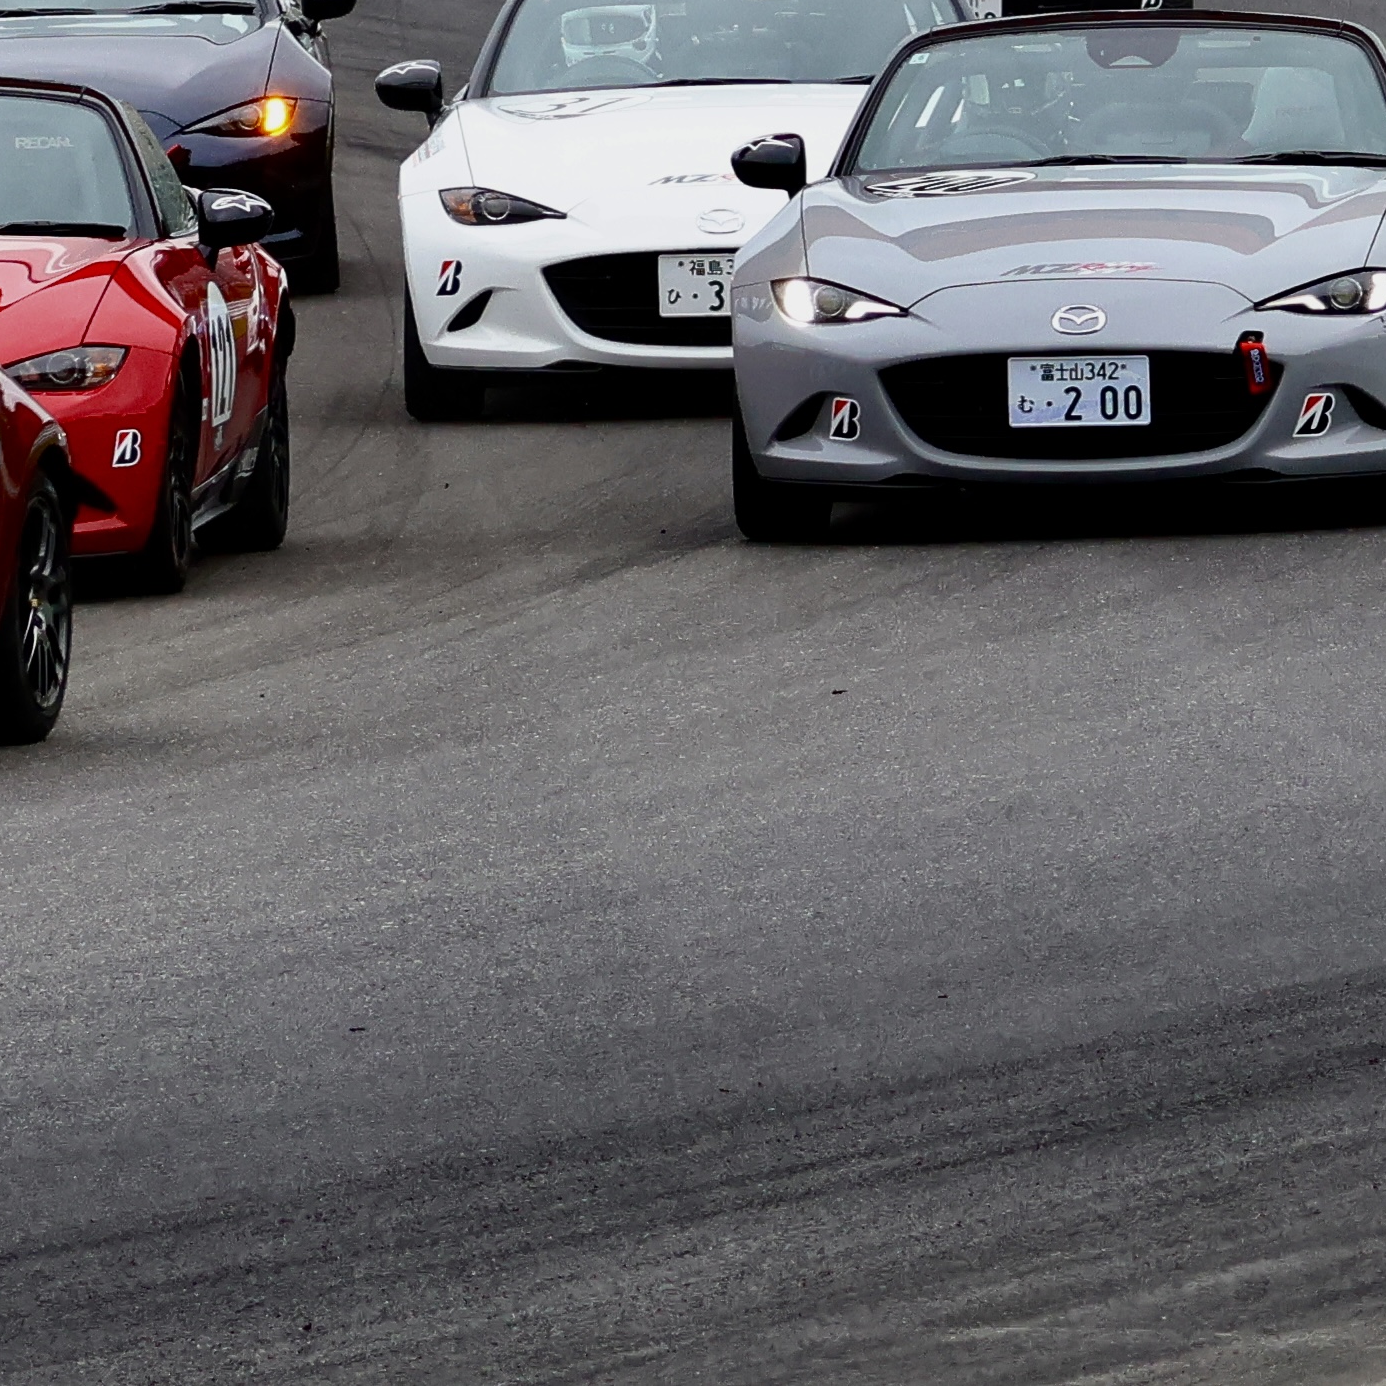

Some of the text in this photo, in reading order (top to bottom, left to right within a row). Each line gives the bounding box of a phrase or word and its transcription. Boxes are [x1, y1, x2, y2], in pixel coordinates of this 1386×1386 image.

[667, 288, 682, 304] ひ
[1039, 362, 1120, 381] 富士山342
[1017, 395, 1035, 413] む
